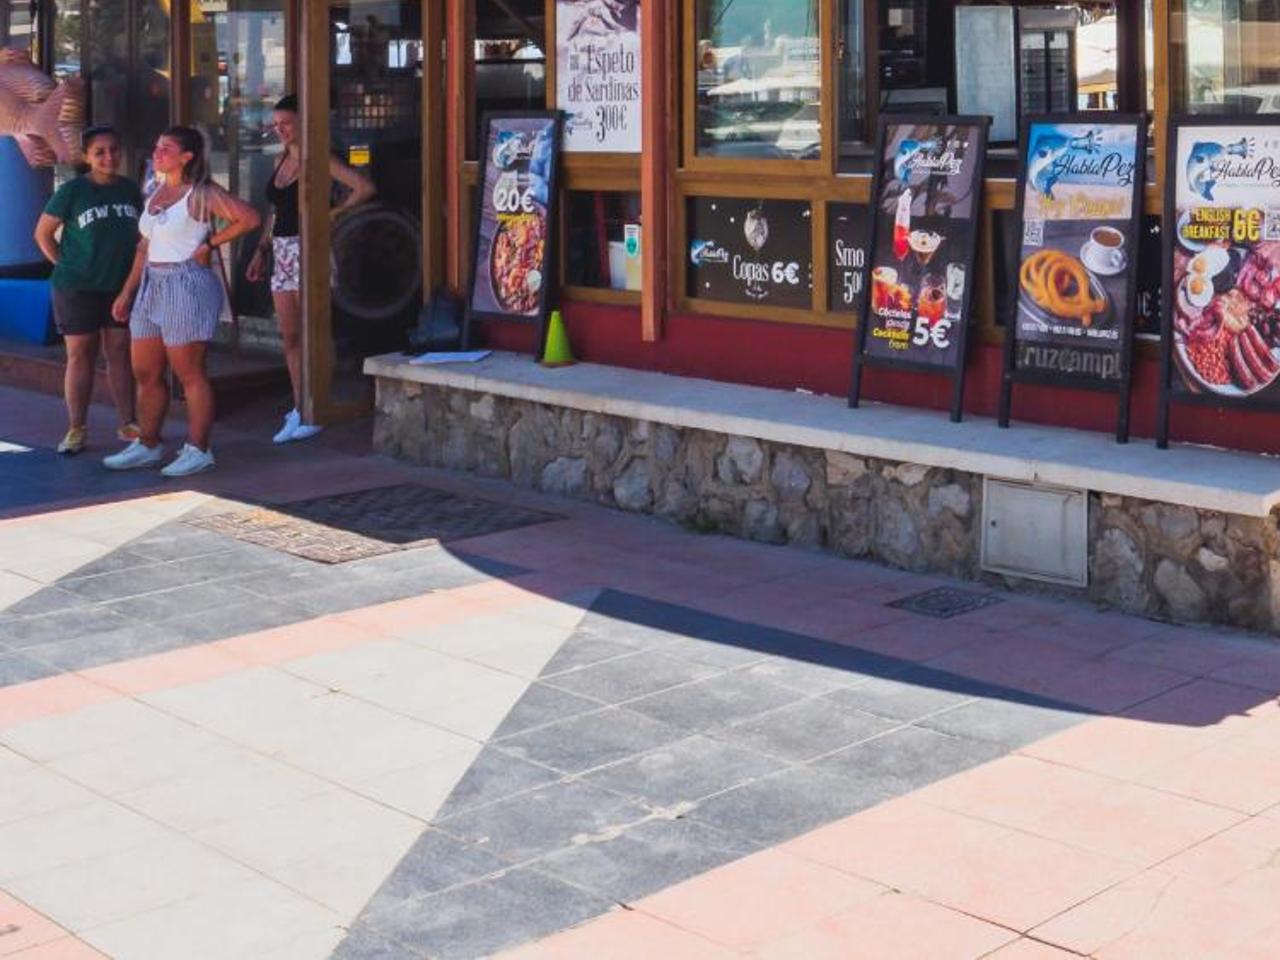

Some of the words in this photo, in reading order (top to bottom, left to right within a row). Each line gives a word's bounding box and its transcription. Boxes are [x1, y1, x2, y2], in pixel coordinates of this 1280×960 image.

[587, 43, 635, 81] Espeto
[567, 78, 583, 102] de
[585, 77, 640, 101] Sardinas
[78, 204, 109, 229] NEW
[1192, 207, 1231, 222] ENGLISH
[1232, 207, 1262, 243] 6€
[732, 254, 770, 287] Copas
[770, 261, 800, 285] 6€
[912, 316, 951, 349] 5€
